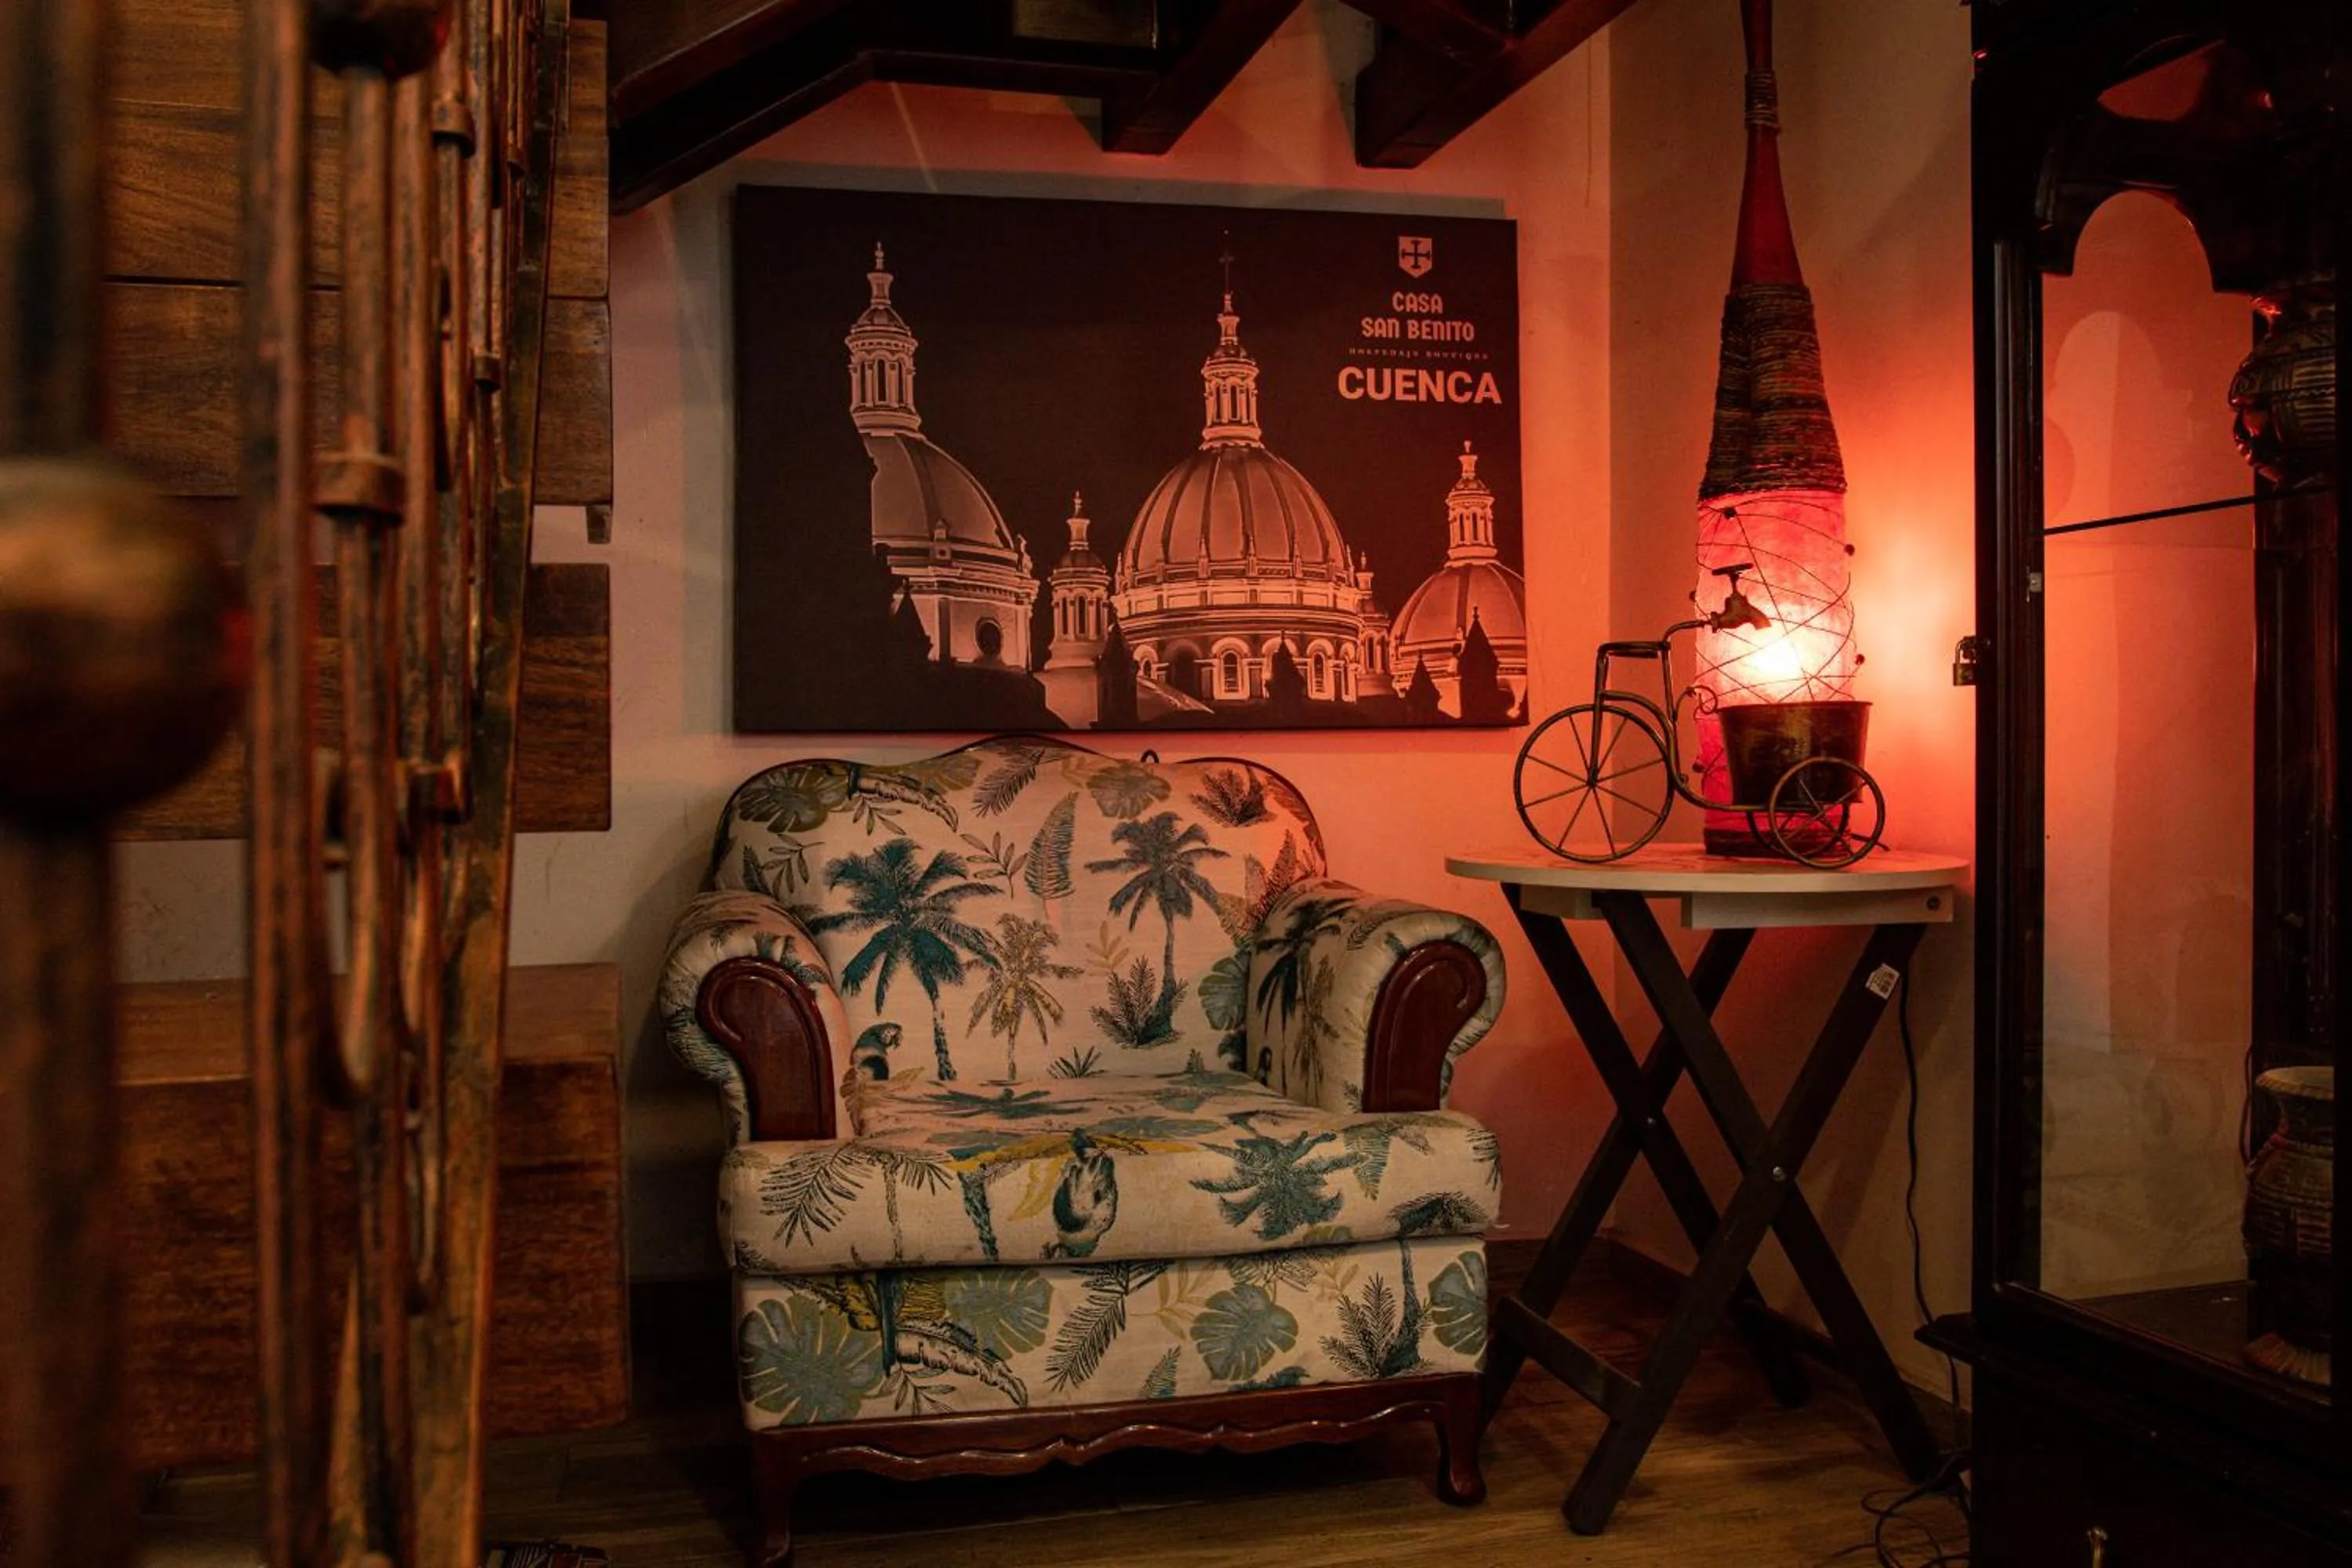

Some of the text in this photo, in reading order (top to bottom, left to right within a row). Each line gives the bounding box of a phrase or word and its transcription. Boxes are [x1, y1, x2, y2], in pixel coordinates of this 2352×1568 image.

[1392, 292, 1443, 314] CASA
[1361, 318, 1475, 341] SAN BENITO
[1338, 366, 1502, 404] CUENCA
